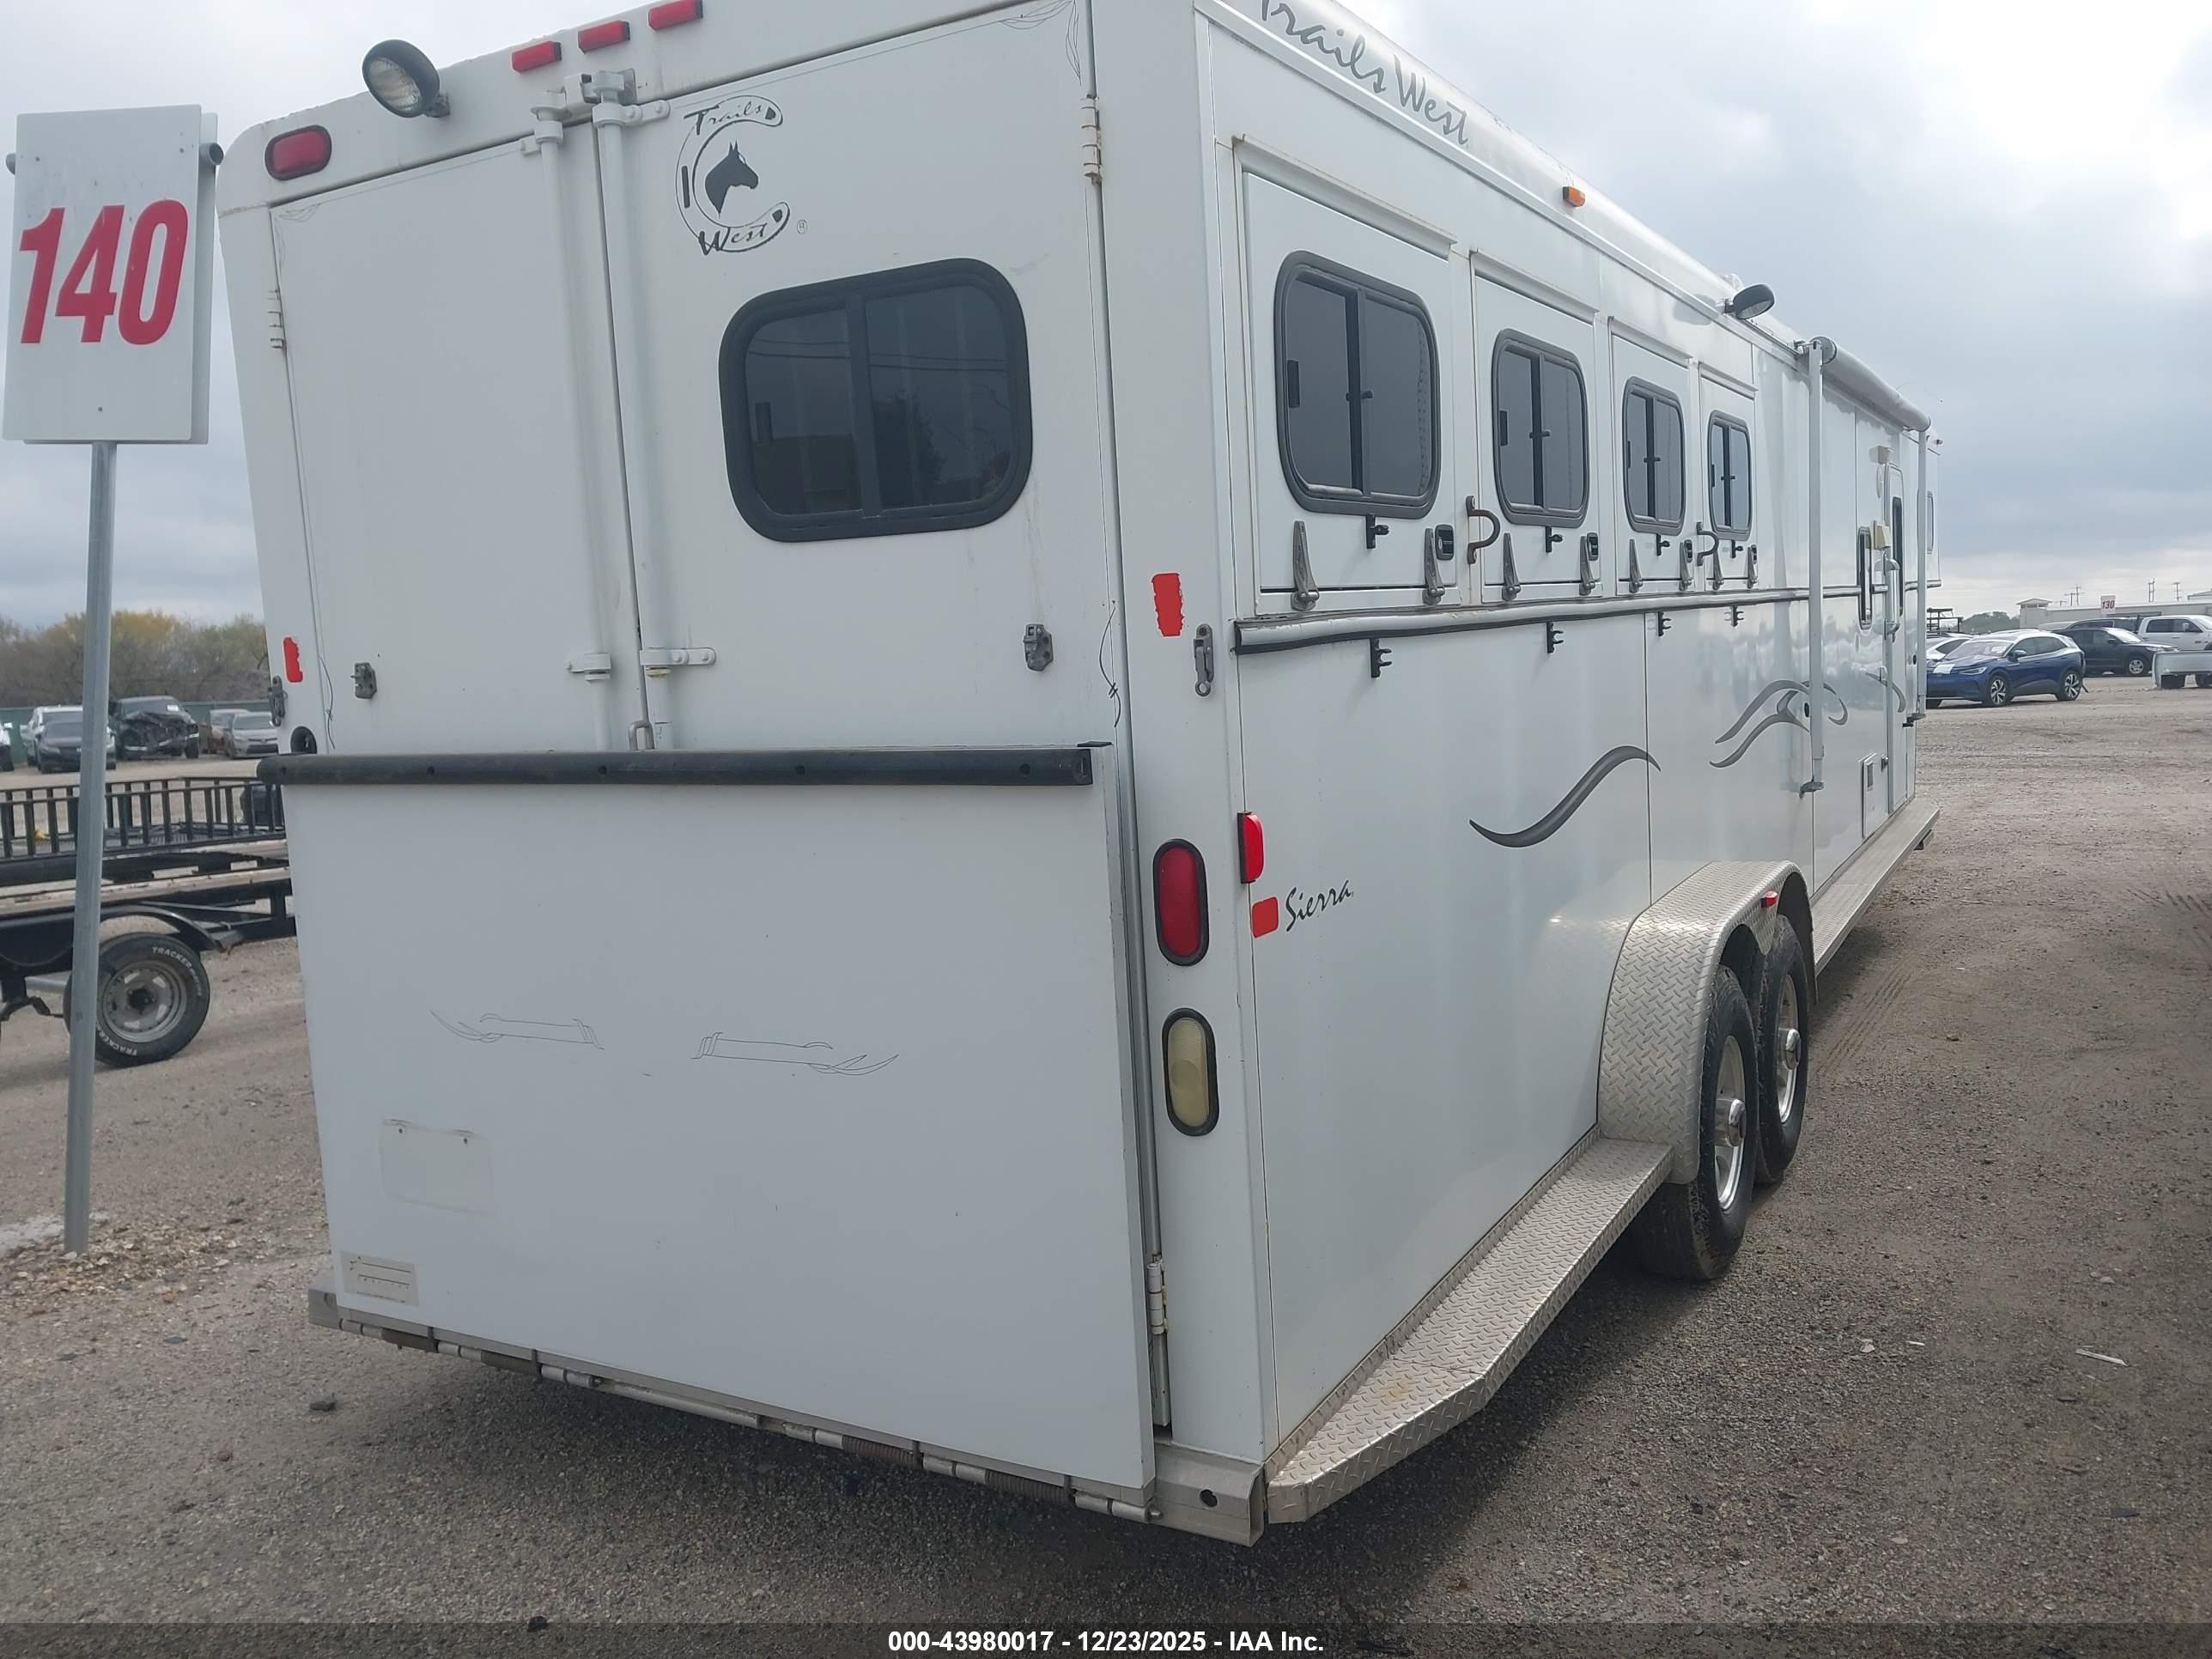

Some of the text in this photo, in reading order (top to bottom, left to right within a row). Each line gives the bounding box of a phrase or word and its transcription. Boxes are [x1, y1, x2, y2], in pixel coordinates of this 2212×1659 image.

[1393, 53, 1469, 145] West
[684, 100, 763, 136] Trails
[698, 222, 768, 256] West
[19, 198, 189, 345] 140
[2101, 600, 2115, 610] 130
[1285, 879, 1352, 933] Sierra
[151, 946, 193, 969] TRACKER
